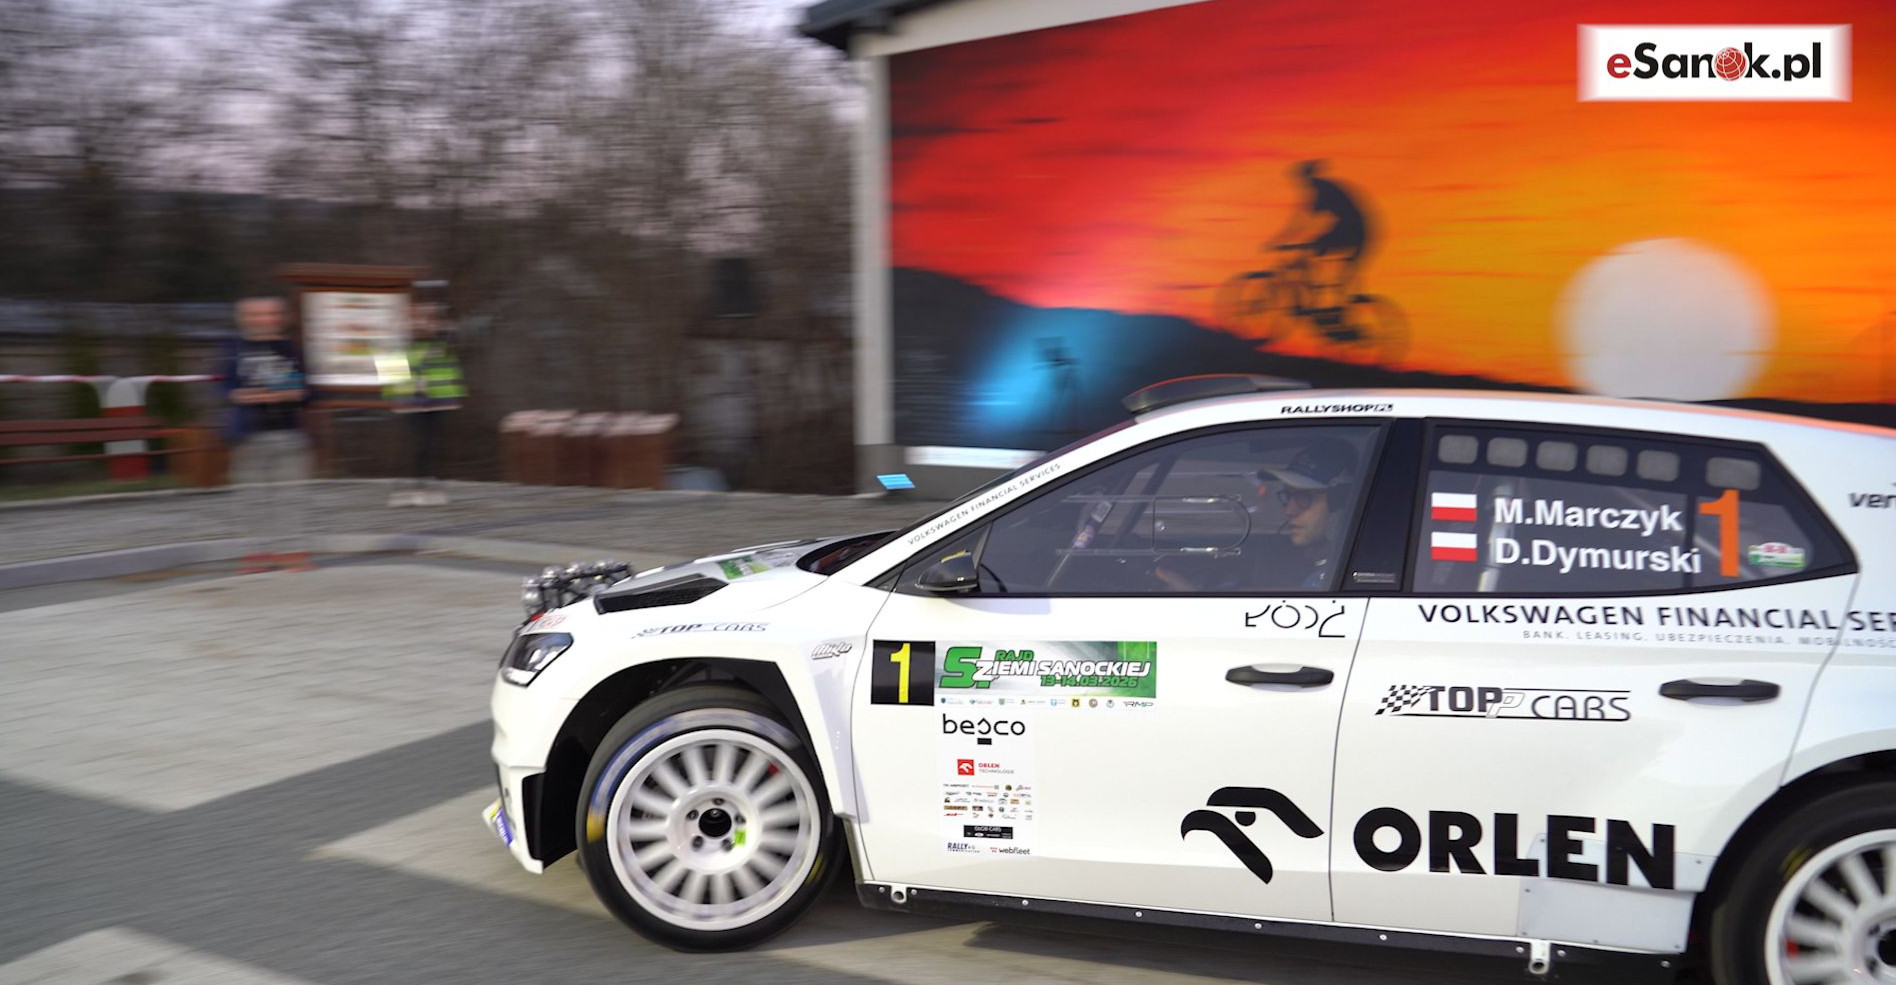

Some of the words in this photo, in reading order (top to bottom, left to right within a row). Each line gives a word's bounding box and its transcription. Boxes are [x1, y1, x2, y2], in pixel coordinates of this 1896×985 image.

[908, 510, 969, 545] VOLKSWAGEN
[970, 484, 1018, 513] FINANCIAL
[1018, 463, 1061, 488] SERVICES
[1494, 498, 1684, 537] M.Marczyk
[1699, 489, 1740, 578] 1
[1495, 537, 1702, 573] D.Dymurski
[1418, 604, 1645, 625] VOLKSWAGEN
[1658, 607, 1840, 630] FINANCIAL
[1523, 630, 1569, 640] BANK.
[994, 650, 1035, 661] RAJD
[889, 643, 911, 703] 1
[972, 660, 1036, 682] ZIEMI
[1037, 660, 1151, 680] SANOCKIEJ
[1040, 675, 1139, 688] 13-14.03.2026
[947, 842, 968, 851] RALLY
[998, 846, 1031, 855] webfleet
[1353, 807, 1676, 890] ORLEN
